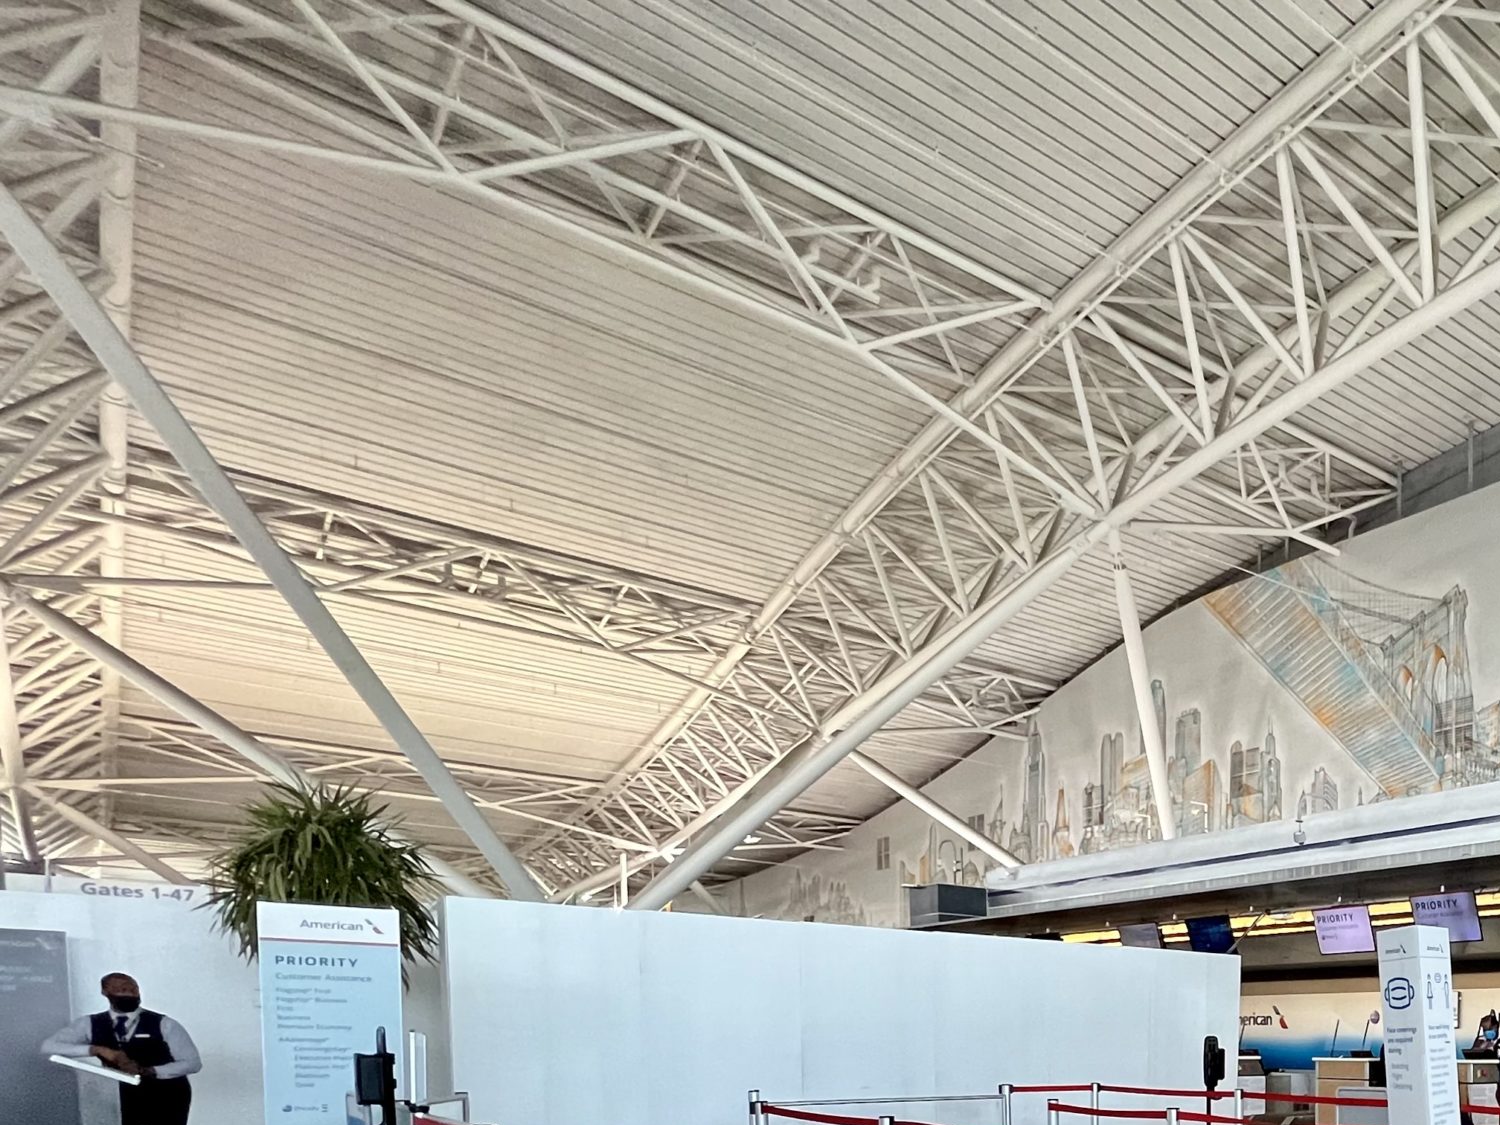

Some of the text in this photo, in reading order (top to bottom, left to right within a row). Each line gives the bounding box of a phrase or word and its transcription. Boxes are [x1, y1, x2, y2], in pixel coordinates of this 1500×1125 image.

[80, 881, 195, 902] Gates 1-47
[1415, 898, 1458, 911] PRIORITY
[299, 918, 364, 932] American
[1316, 913, 1354, 924] PRIORITY
[274, 954, 359, 968] PRIORITY
